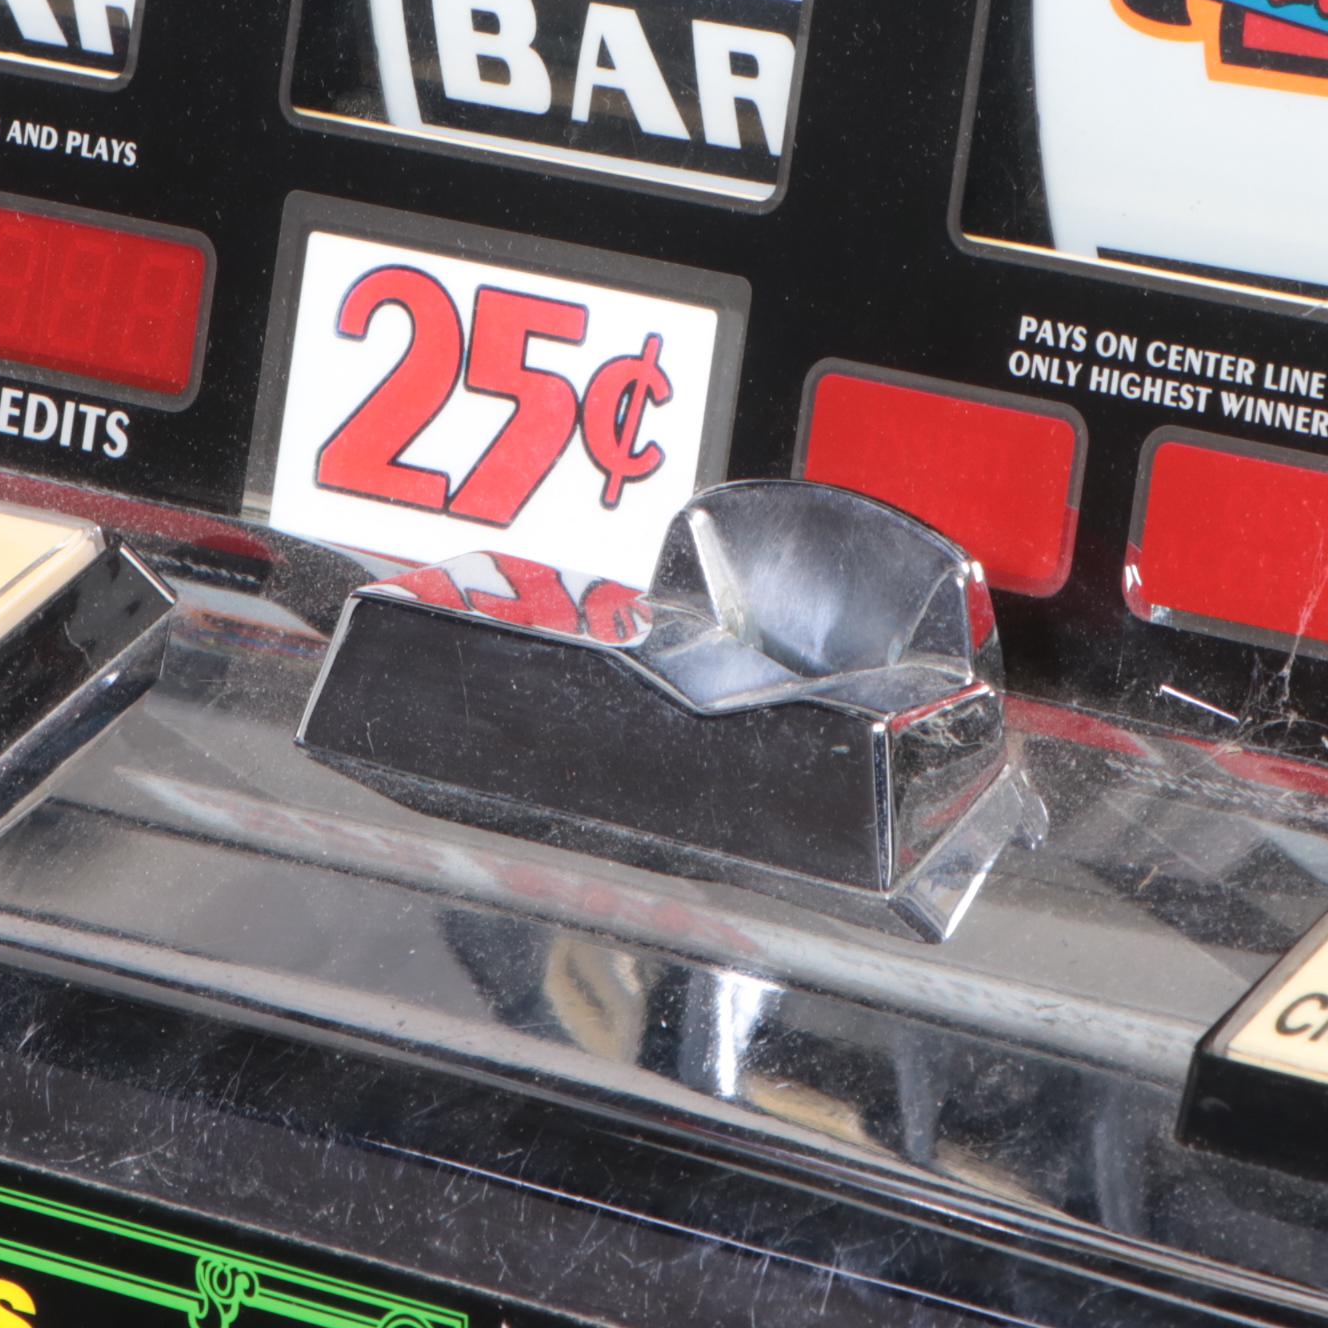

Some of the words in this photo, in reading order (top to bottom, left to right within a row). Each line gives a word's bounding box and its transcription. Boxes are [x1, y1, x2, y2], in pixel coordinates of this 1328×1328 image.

[6, 119, 58, 151] AND
[65, 131, 138, 167] PLAYS
[1009, 350, 1082, 388] ONLY
[1088, 366, 1212, 416] HIGHEST
[1018, 315, 1088, 355] PAYS
[1095, 328, 1138, 363] ON
[1146, 337, 1257, 383] CENTER
[1265, 359, 1327, 399] LINE
[315, 264, 673, 529] 25¢
